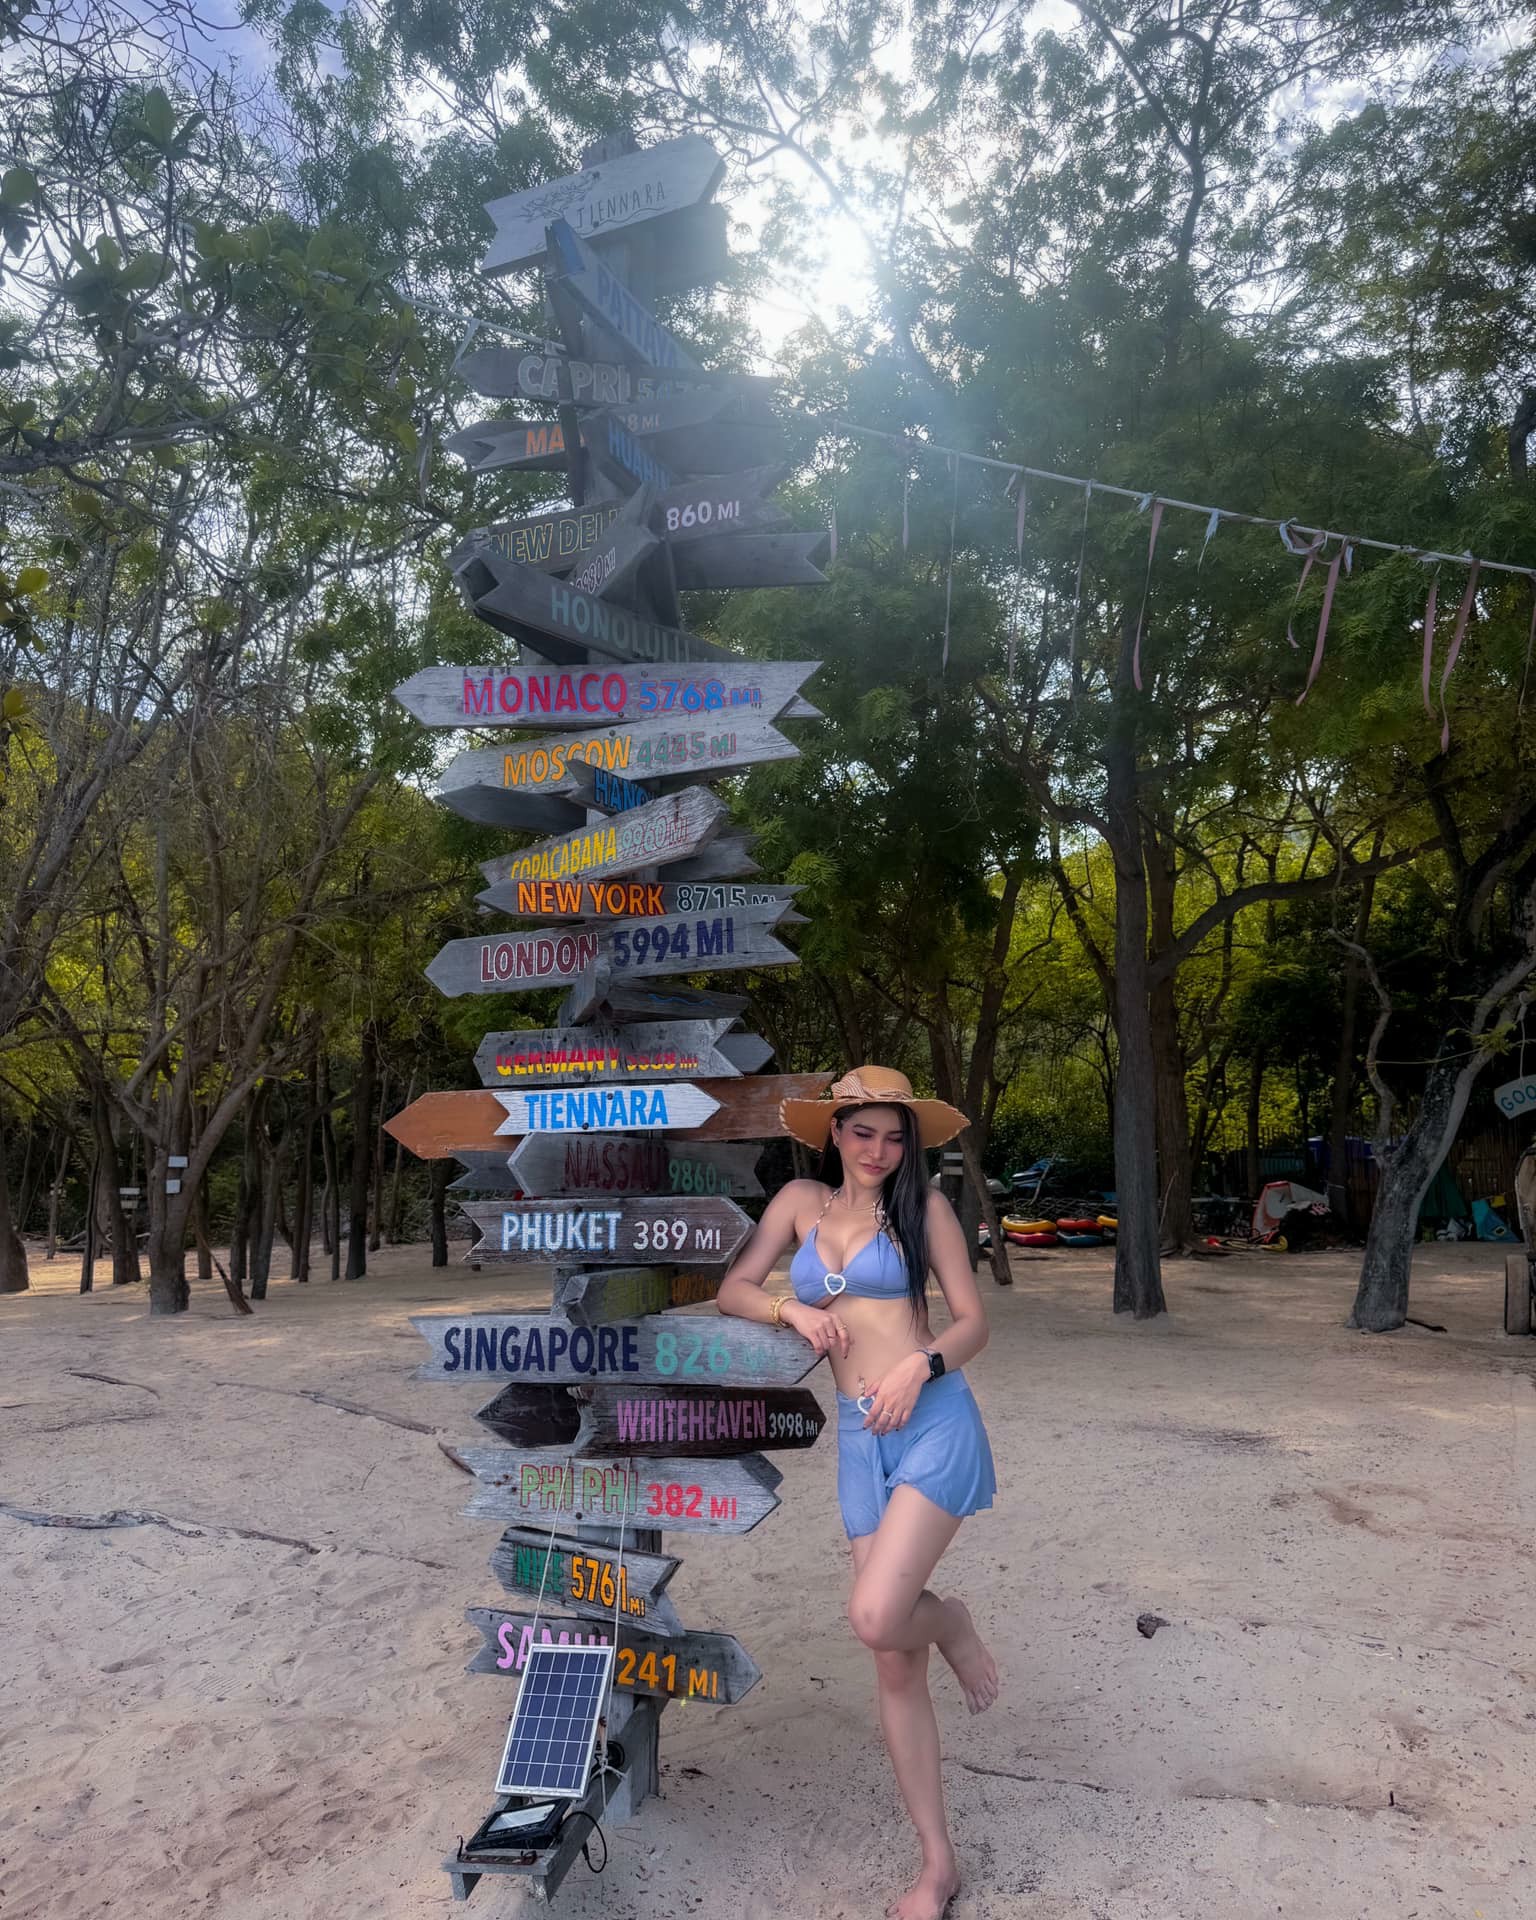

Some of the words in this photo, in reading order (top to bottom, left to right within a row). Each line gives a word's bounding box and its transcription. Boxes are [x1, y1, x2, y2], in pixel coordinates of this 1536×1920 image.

[576, 180, 666, 229] TIENNARA
[517, 355, 632, 405] CAPRI
[666, 500, 713, 531] 860
[717, 500, 741, 521] MI
[488, 522, 554, 565] NEW
[462, 672, 628, 714] MONACO
[638, 678, 726, 712] 5768
[730, 687, 761, 708] MI
[637, 732, 706, 767] 4445
[710, 732, 737, 758] MI
[594, 766, 654, 812] HANO
[511, 827, 617, 880] COPACABANA
[517, 881, 583, 914] NEW
[589, 882, 667, 916] YORK
[677, 885, 747, 913] 8715
[480, 931, 600, 983] LONDON
[612, 922, 691, 968] 5994
[696, 916, 735, 956] MI
[495, 1037, 620, 1077] GERMANY
[524, 1089, 669, 1130] TIENNARA
[564, 1139, 669, 1191] NASSAU
[668, 1158, 717, 1194] 9860
[502, 1210, 623, 1251] PHUKET
[632, 1219, 689, 1251] 389
[695, 1228, 722, 1250] MI
[443, 1326, 640, 1373] SINGAPORE
[655, 1332, 731, 1376] 826
[616, 1399, 767, 1443] WHITEHEAVEN
[768, 1412, 804, 1440] 3998
[519, 1463, 574, 1511] PHI
[582, 1463, 639, 1515] PHI
[646, 1483, 703, 1518] 382
[709, 1496, 737, 1520] MI
[571, 1555, 628, 1614] 5761
[629, 1596, 646, 1617] MI
[617, 1647, 678, 1692] 241
[688, 1668, 718, 1699] MI
